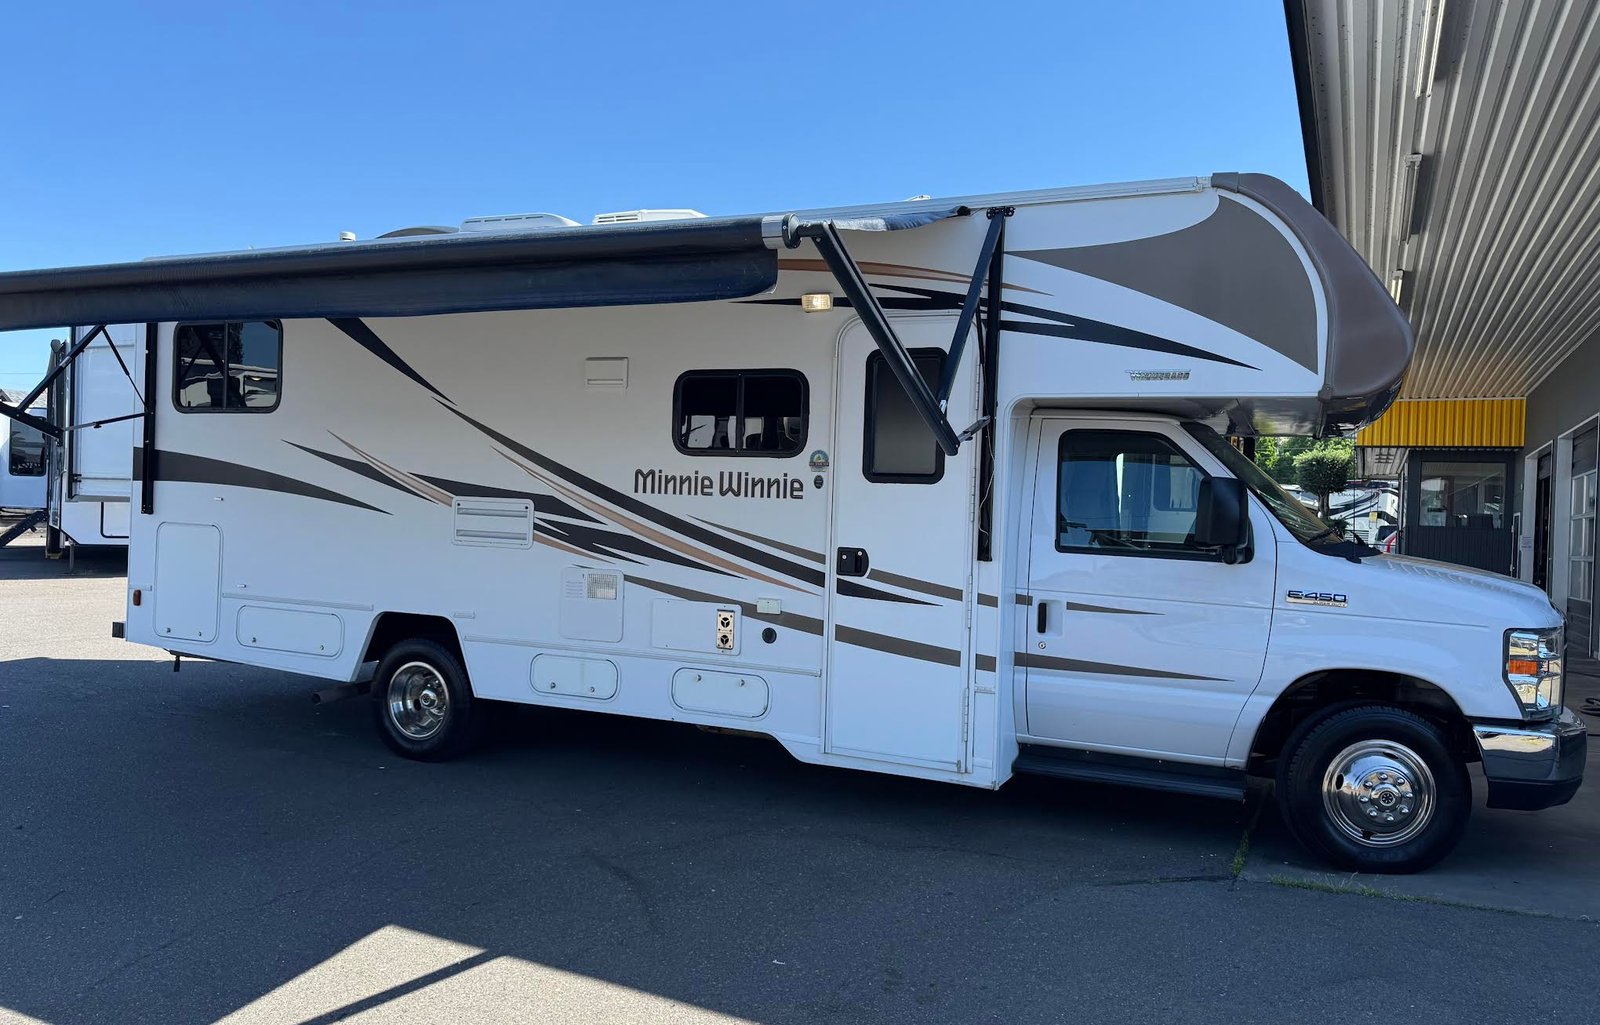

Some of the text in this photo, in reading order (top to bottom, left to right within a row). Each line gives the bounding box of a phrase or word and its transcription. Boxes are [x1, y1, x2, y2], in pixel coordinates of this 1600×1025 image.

[634, 468, 714, 496] Minnie
[719, 471, 804, 500] Winnie
[1287, 590, 1347, 603] E-450
